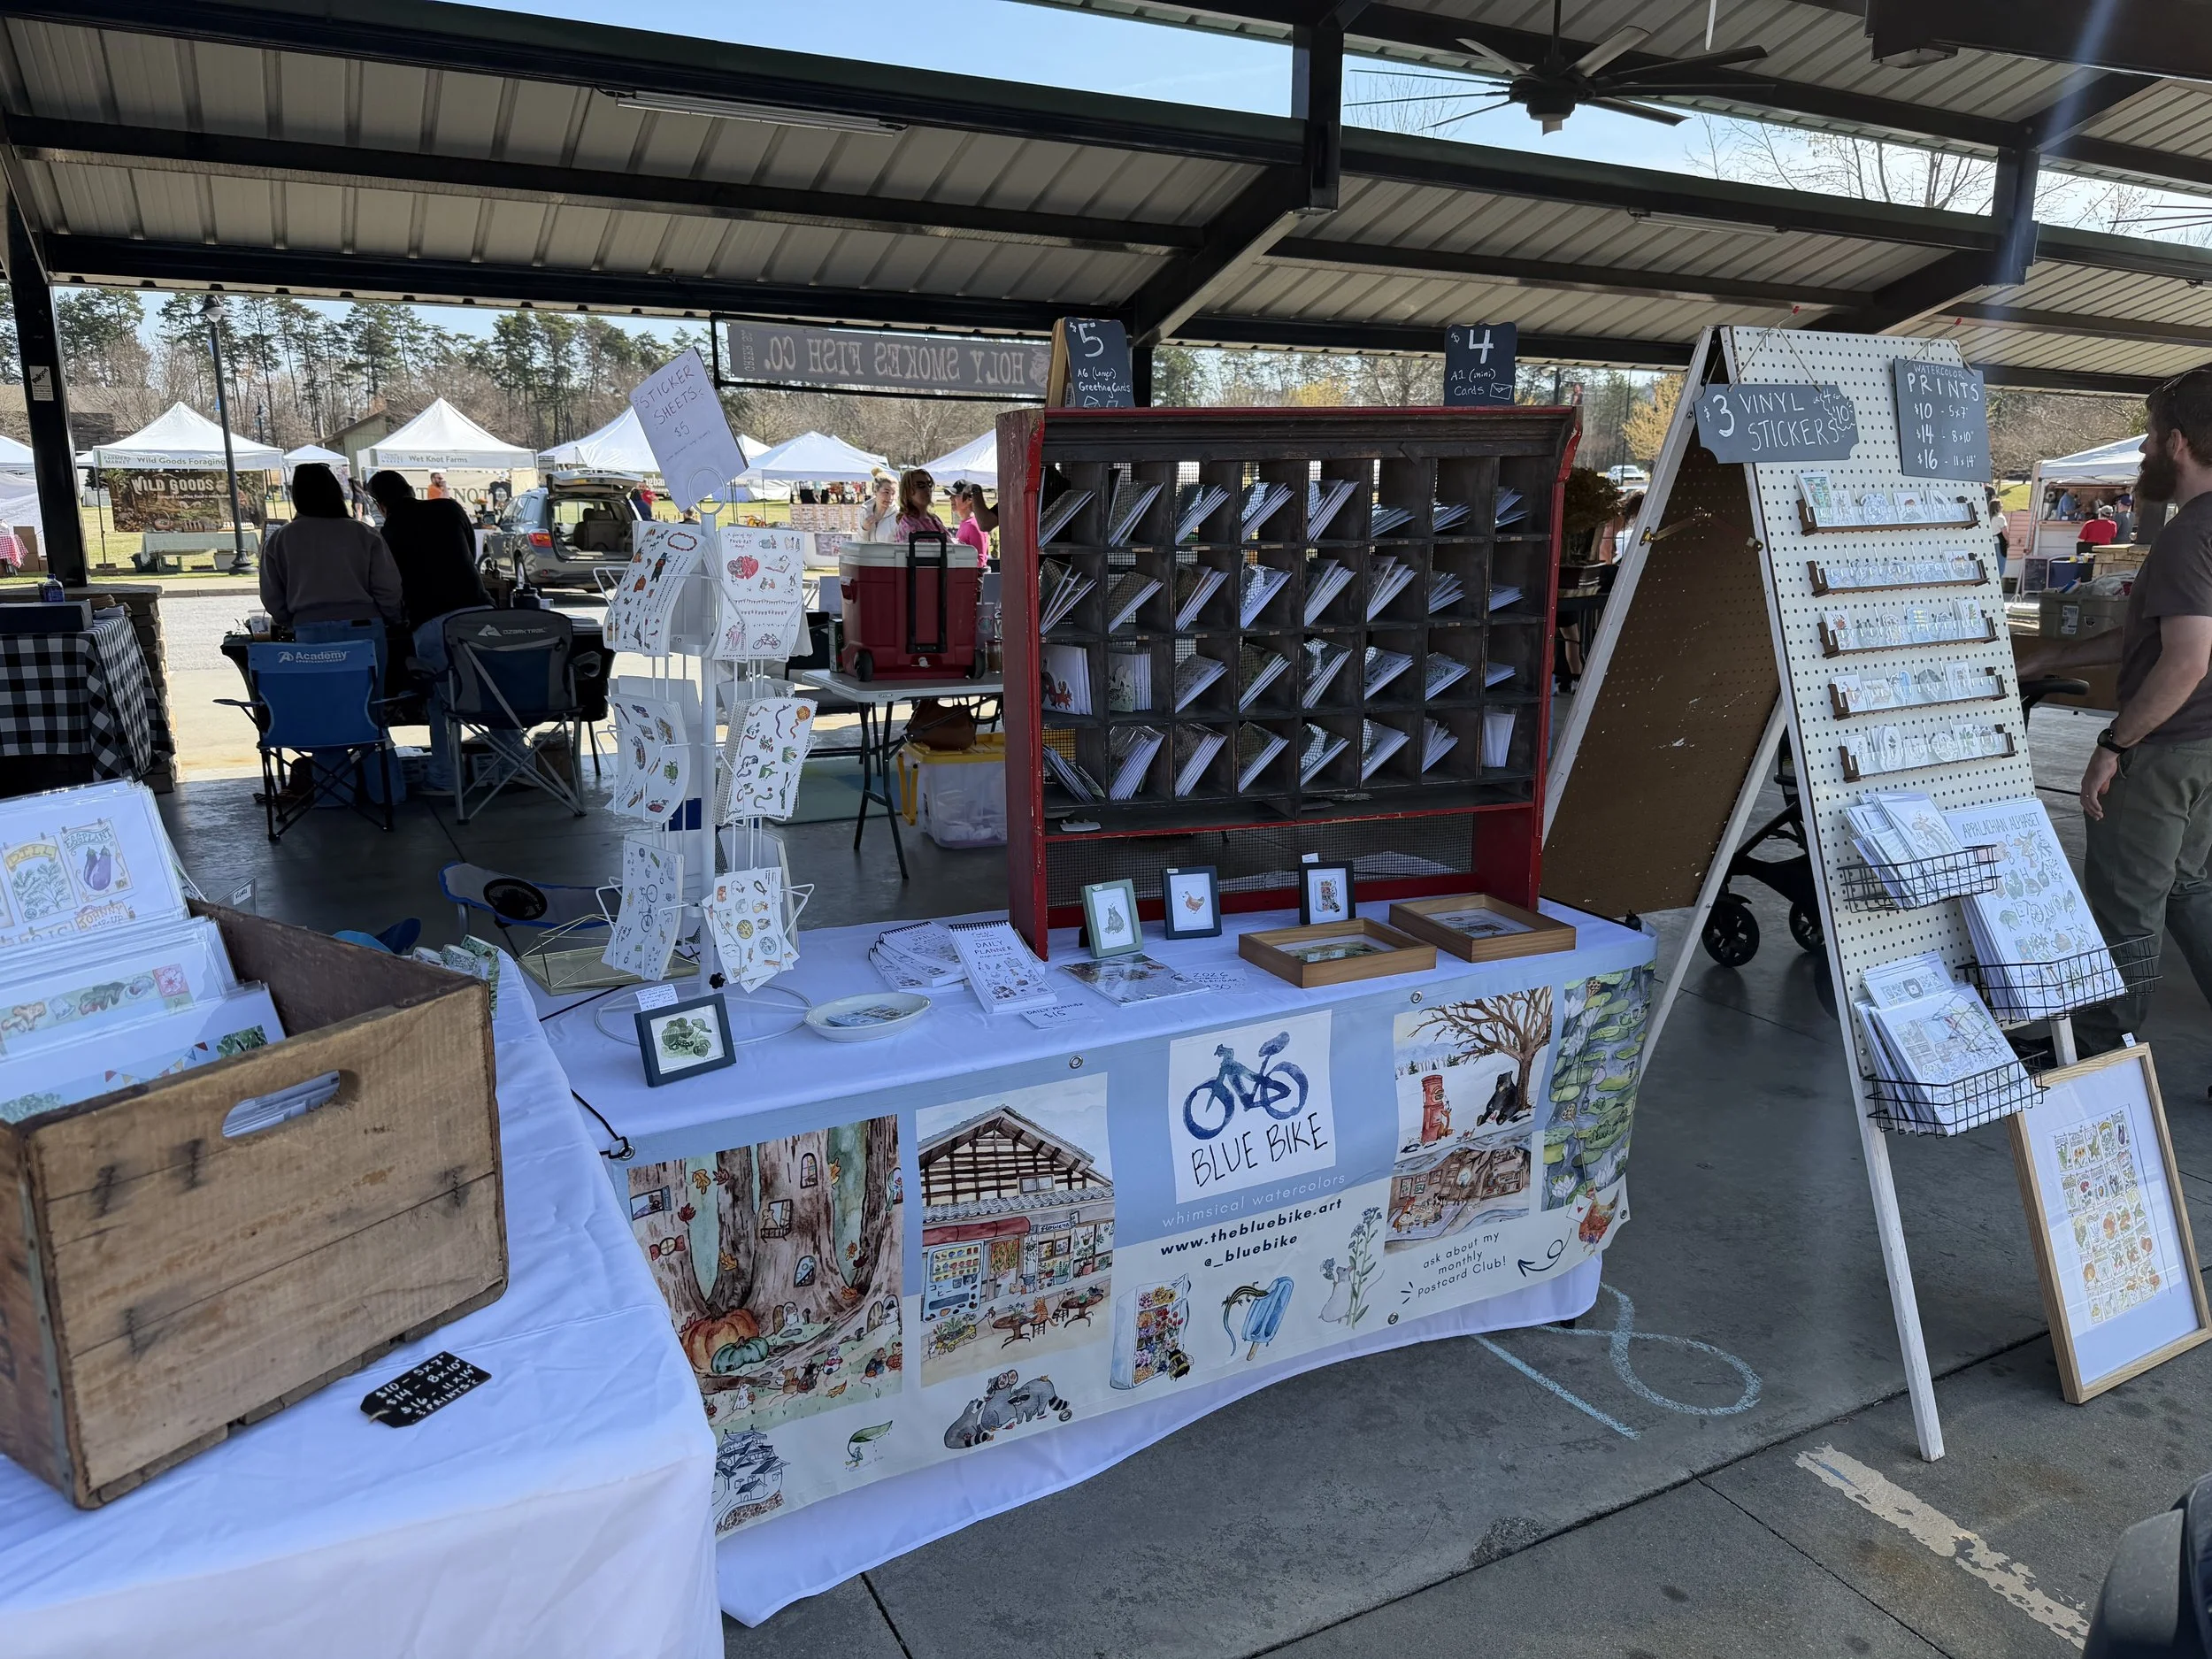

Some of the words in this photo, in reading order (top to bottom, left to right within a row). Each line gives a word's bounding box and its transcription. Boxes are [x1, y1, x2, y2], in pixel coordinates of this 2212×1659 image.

[1069, 321, 1104, 357] $5
[1451, 329, 1494, 364] $4
[1077, 368, 1088, 378] A6
[1469, 368, 1496, 382] (mini)
[1914, 364, 1964, 380] WATERCOLOR
[640, 365, 695, 409] STICKER
[1079, 381, 1114, 398] Greeting
[1112, 382, 1131, 393] Cards
[1454, 386, 1484, 396] Cards
[1907, 373, 1979, 402] PRINTS
[654, 386, 697, 425] SHEETS
[1703, 394, 1735, 437] $3
[1739, 392, 1805, 414] VINYL
[1914, 403, 1932, 420] $10
[674, 420, 690, 437] $5
[1748, 418, 1839, 451] STICKERS
[1916, 424, 1934, 444] $14
[188, 457, 227, 466] Foraging
[1917, 449, 1938, 470] $16
[132, 475, 165, 495] WILD
[169, 479, 215, 495] GOODS
[296, 651, 348, 661] Academy
[1962, 818, 2008, 839] APPALACHIAN
[2009, 811, 2042, 831] ALPHABET
[65, 826, 114, 849] EGGPLANT
[10, 845, 53, 864] DILL
[78, 904, 122, 928] JOHNNY
[974, 946, 1013, 955] PLANNER
[975, 940, 1002, 949] DAILY
[1043, 1010, 1066, 1018] $15
[1192, 1131, 1258, 1187] BLUE
[1266, 1112, 1328, 1162] BIKE
[1163, 1196, 1245, 1228] whimsical
[1252, 1174, 1345, 1206] watercolors
[1160, 1198, 1342, 1256] www.thebluebike.art
[1204, 1234, 1298, 1267] @_bluebike
[1423, 1253, 1440, 1269] ask
[1446, 1238, 1478, 1258] about
[1483, 1233, 1499, 1242] my
[1439, 1250, 1483, 1274] monthly
[1417, 1268, 1467, 1298] postcard
[1472, 1256, 1506, 1273] Club!
[375, 1382, 400, 1398] $10
[386, 1388, 413, 1405] $14
[426, 1383, 469, 1410] PRINTS
[400, 1397, 427, 1414] $16
